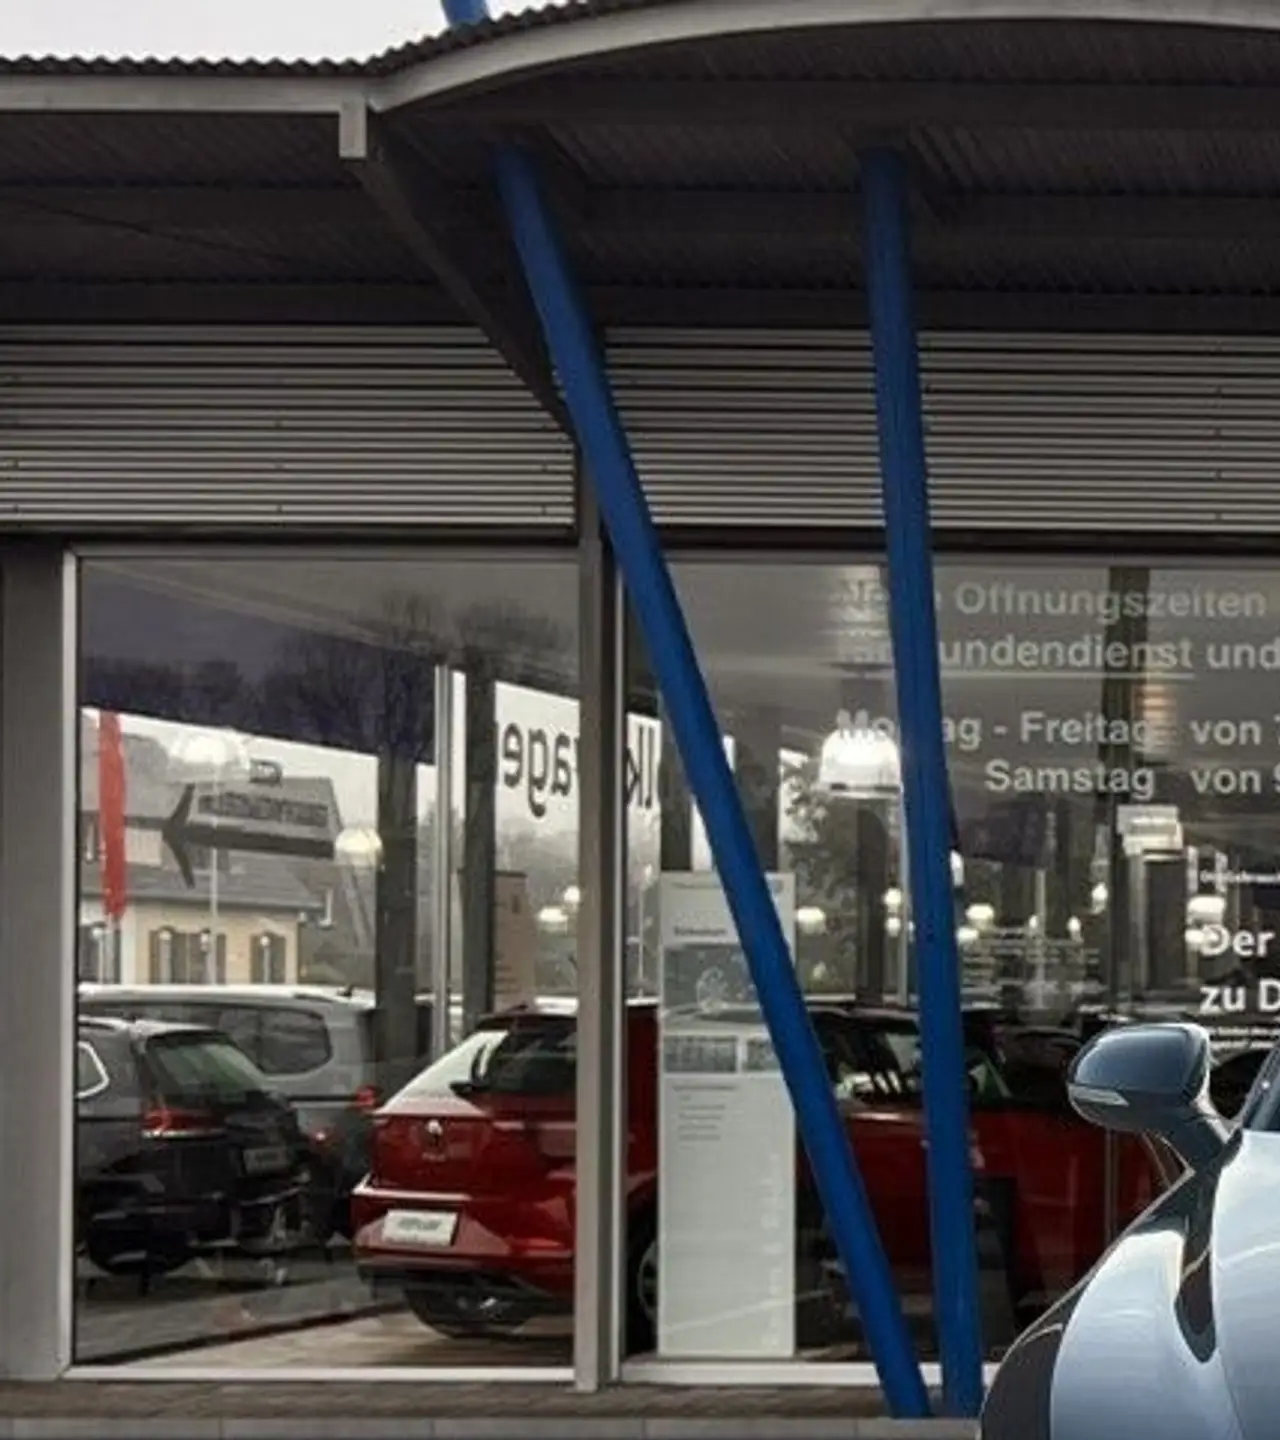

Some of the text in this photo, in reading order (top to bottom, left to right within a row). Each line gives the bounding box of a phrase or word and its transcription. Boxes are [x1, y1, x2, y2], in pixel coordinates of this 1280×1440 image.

[938, 634, 1193, 669] undendienst
[1020, 709, 1152, 752] Freitag
[1190, 720, 1262, 746] von
[984, 758, 1156, 800] Samstag
[1190, 769, 1262, 794] von
[1200, 924, 1275, 957] Der
[1200, 987, 1246, 1013] zu
